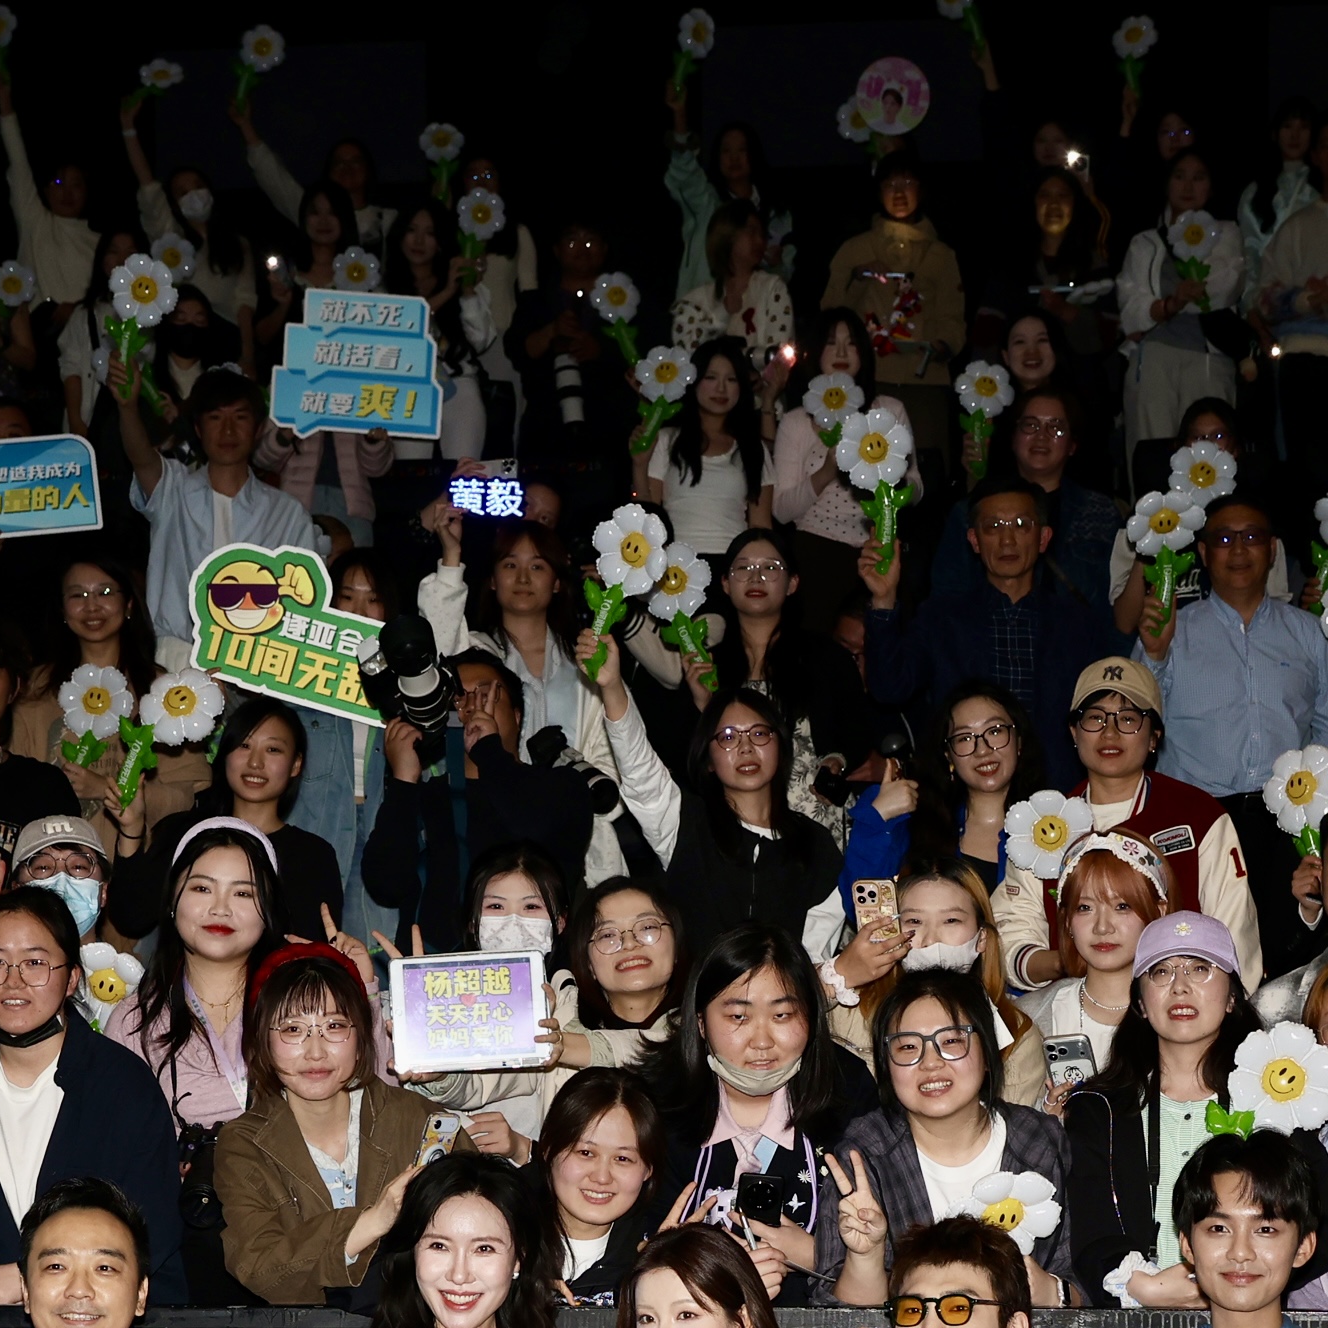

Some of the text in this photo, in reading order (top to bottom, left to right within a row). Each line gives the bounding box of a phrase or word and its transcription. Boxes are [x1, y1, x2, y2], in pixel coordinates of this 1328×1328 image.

[449, 478, 523, 517] 黄毅
[423, 966, 512, 1000] 杨超越
[426, 1001, 514, 1027] 天天开心
[426, 1025, 515, 1050] 妈妈爱你
